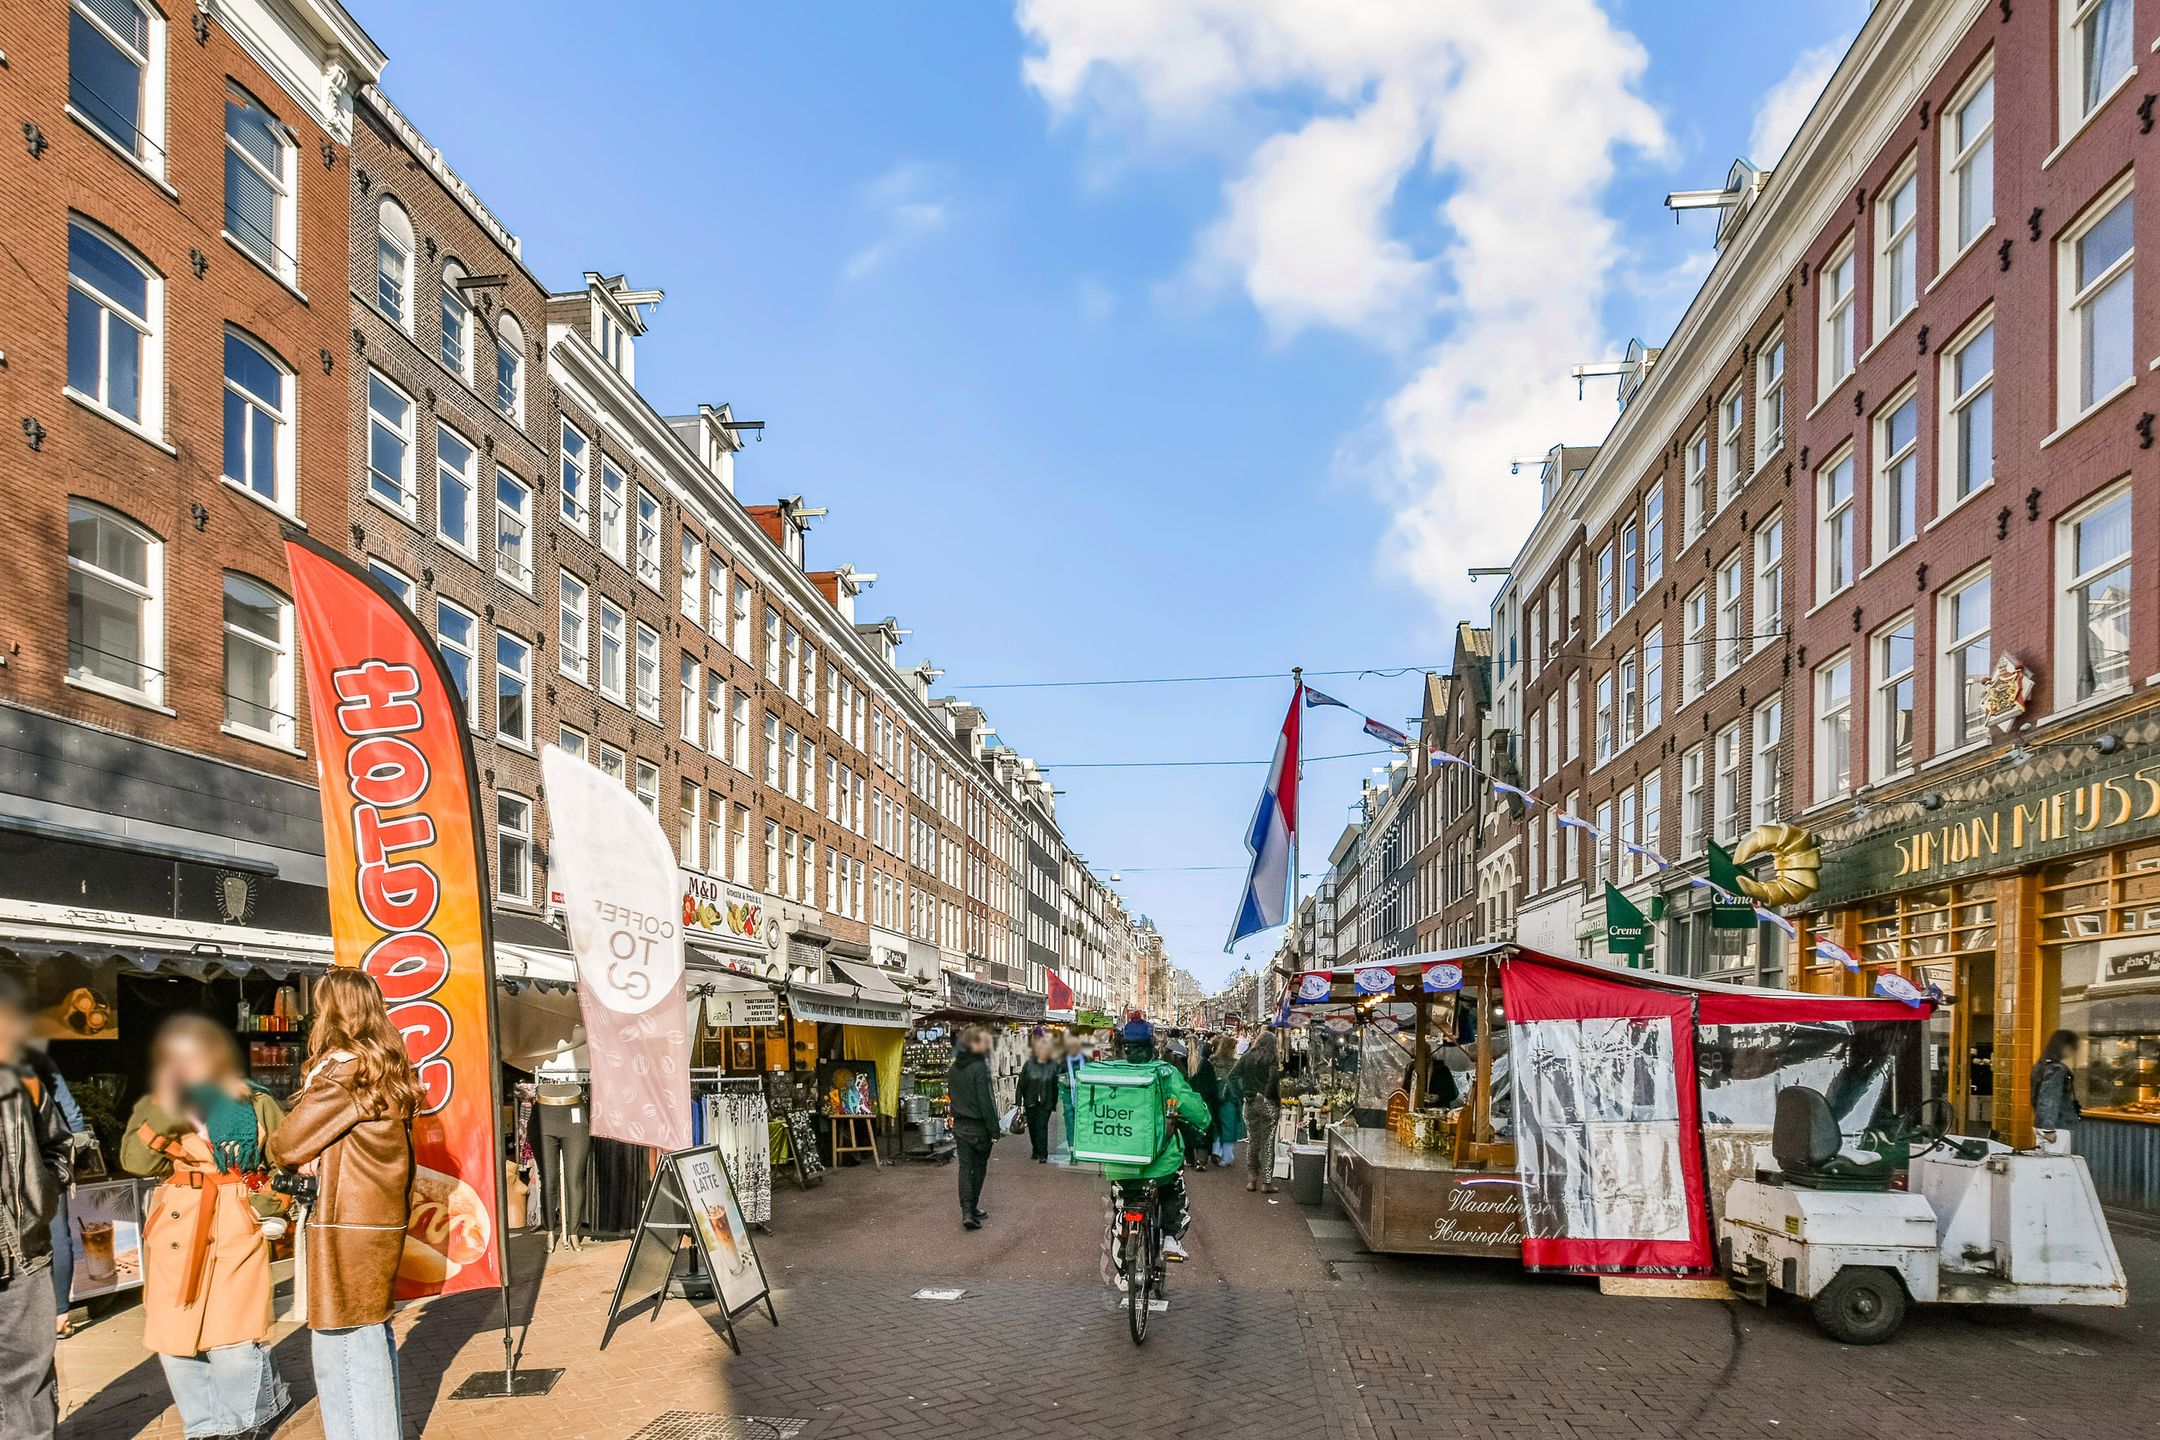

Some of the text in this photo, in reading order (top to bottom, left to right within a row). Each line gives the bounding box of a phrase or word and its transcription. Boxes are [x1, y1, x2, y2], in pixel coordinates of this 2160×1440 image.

[1893, 811, 2000, 878] SIMON
[688, 876, 718, 902] M&D
[1609, 925, 1642, 936] Crema
[1094, 1104, 1134, 1120] Uber
[1093, 1120, 1133, 1137] Eats
[692, 1161, 710, 1177] ICED
[692, 1173, 720, 1194] LATTE
